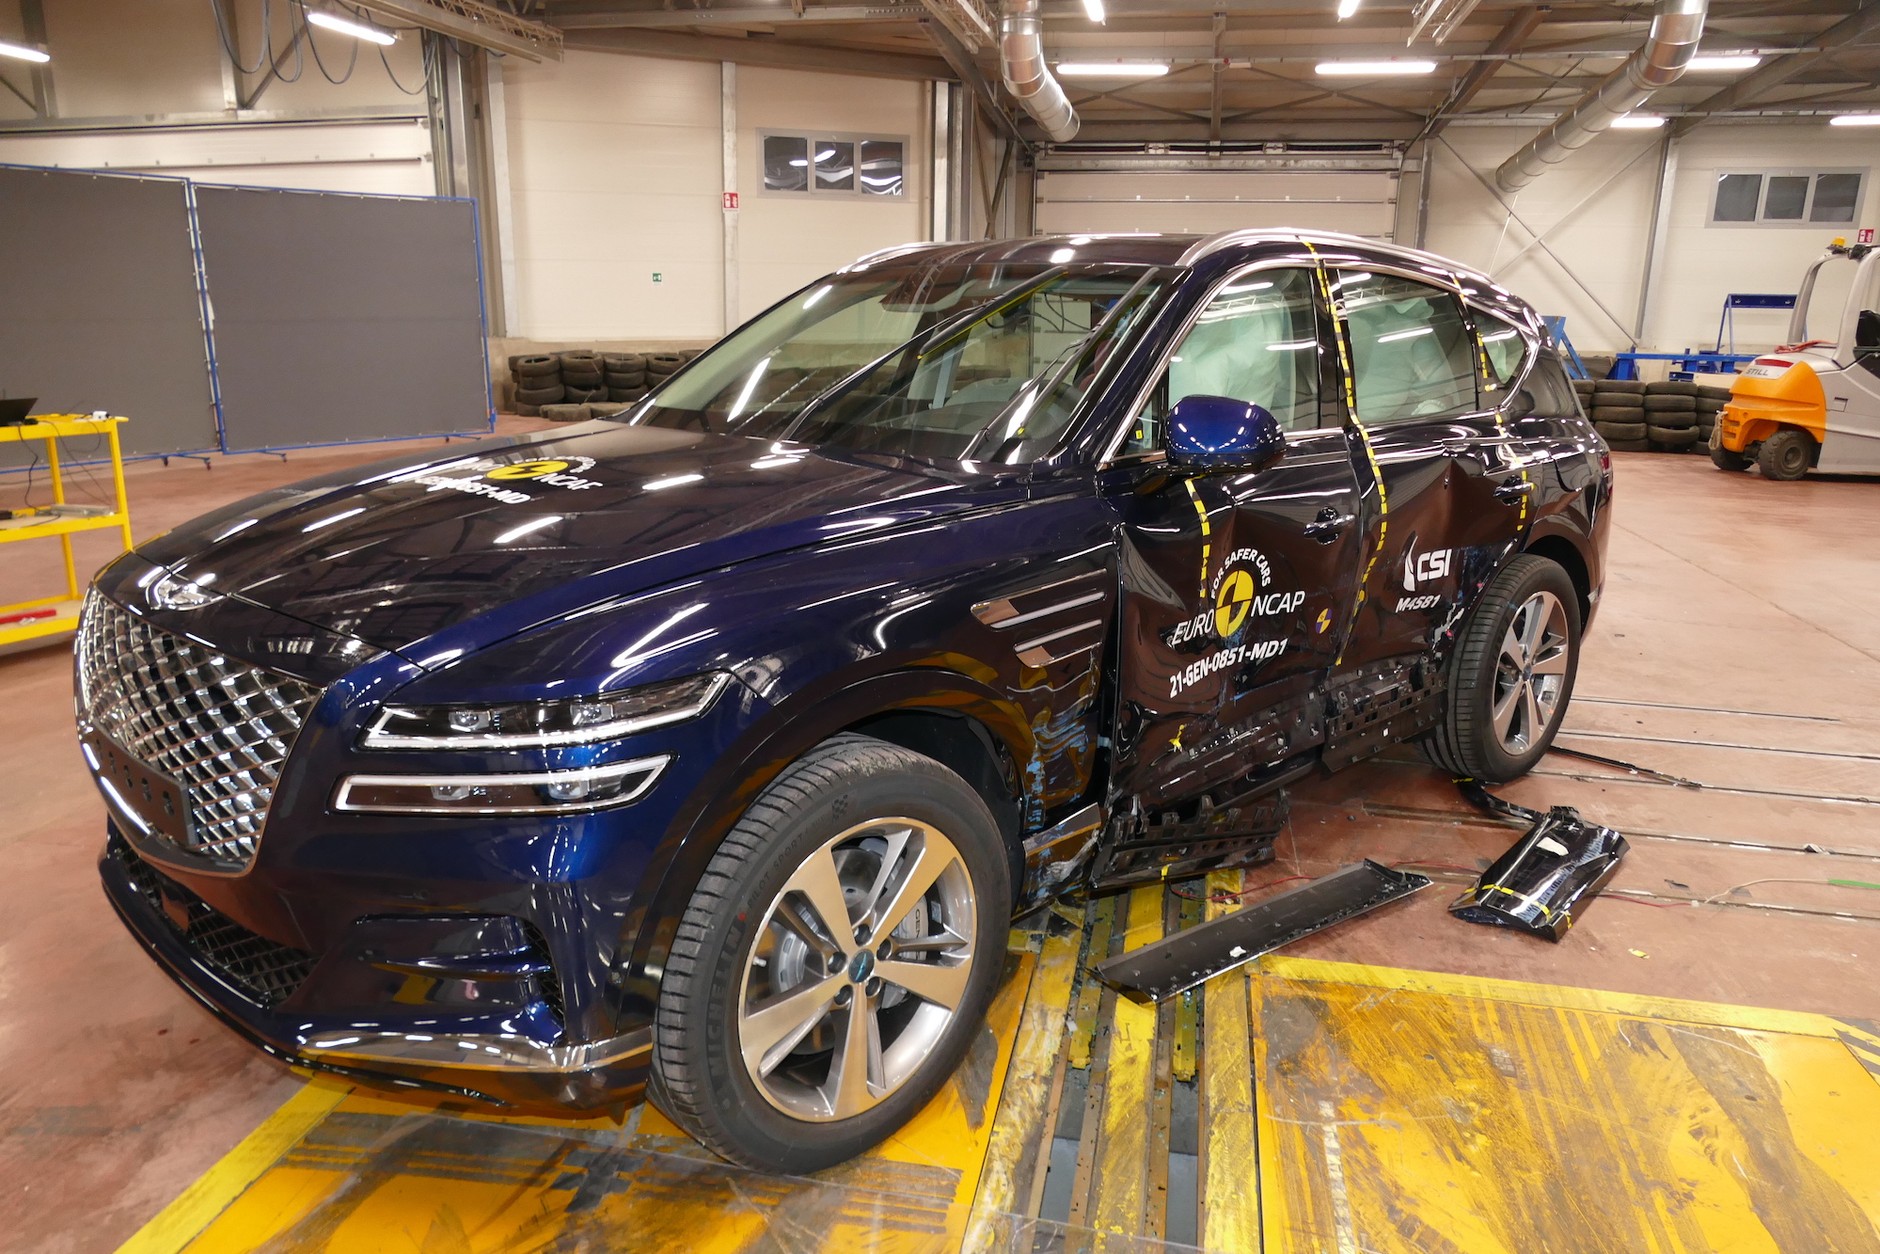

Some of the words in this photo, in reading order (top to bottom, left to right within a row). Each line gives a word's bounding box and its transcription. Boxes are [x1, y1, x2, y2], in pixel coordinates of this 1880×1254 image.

[1745, 368, 1768, 376] STILL
[1211, 567, 1225, 599] FOR
[1225, 548, 1258, 570] SAFER
[1256, 555, 1271, 587] CARS
[1417, 548, 1452, 582] CSI
[1172, 608, 1214, 645] EURO
[1251, 590, 1305, 617] NCAP
[1395, 594, 1441, 613] M4581
[1169, 638, 1288, 698] 21-GEN-0851-MD1
